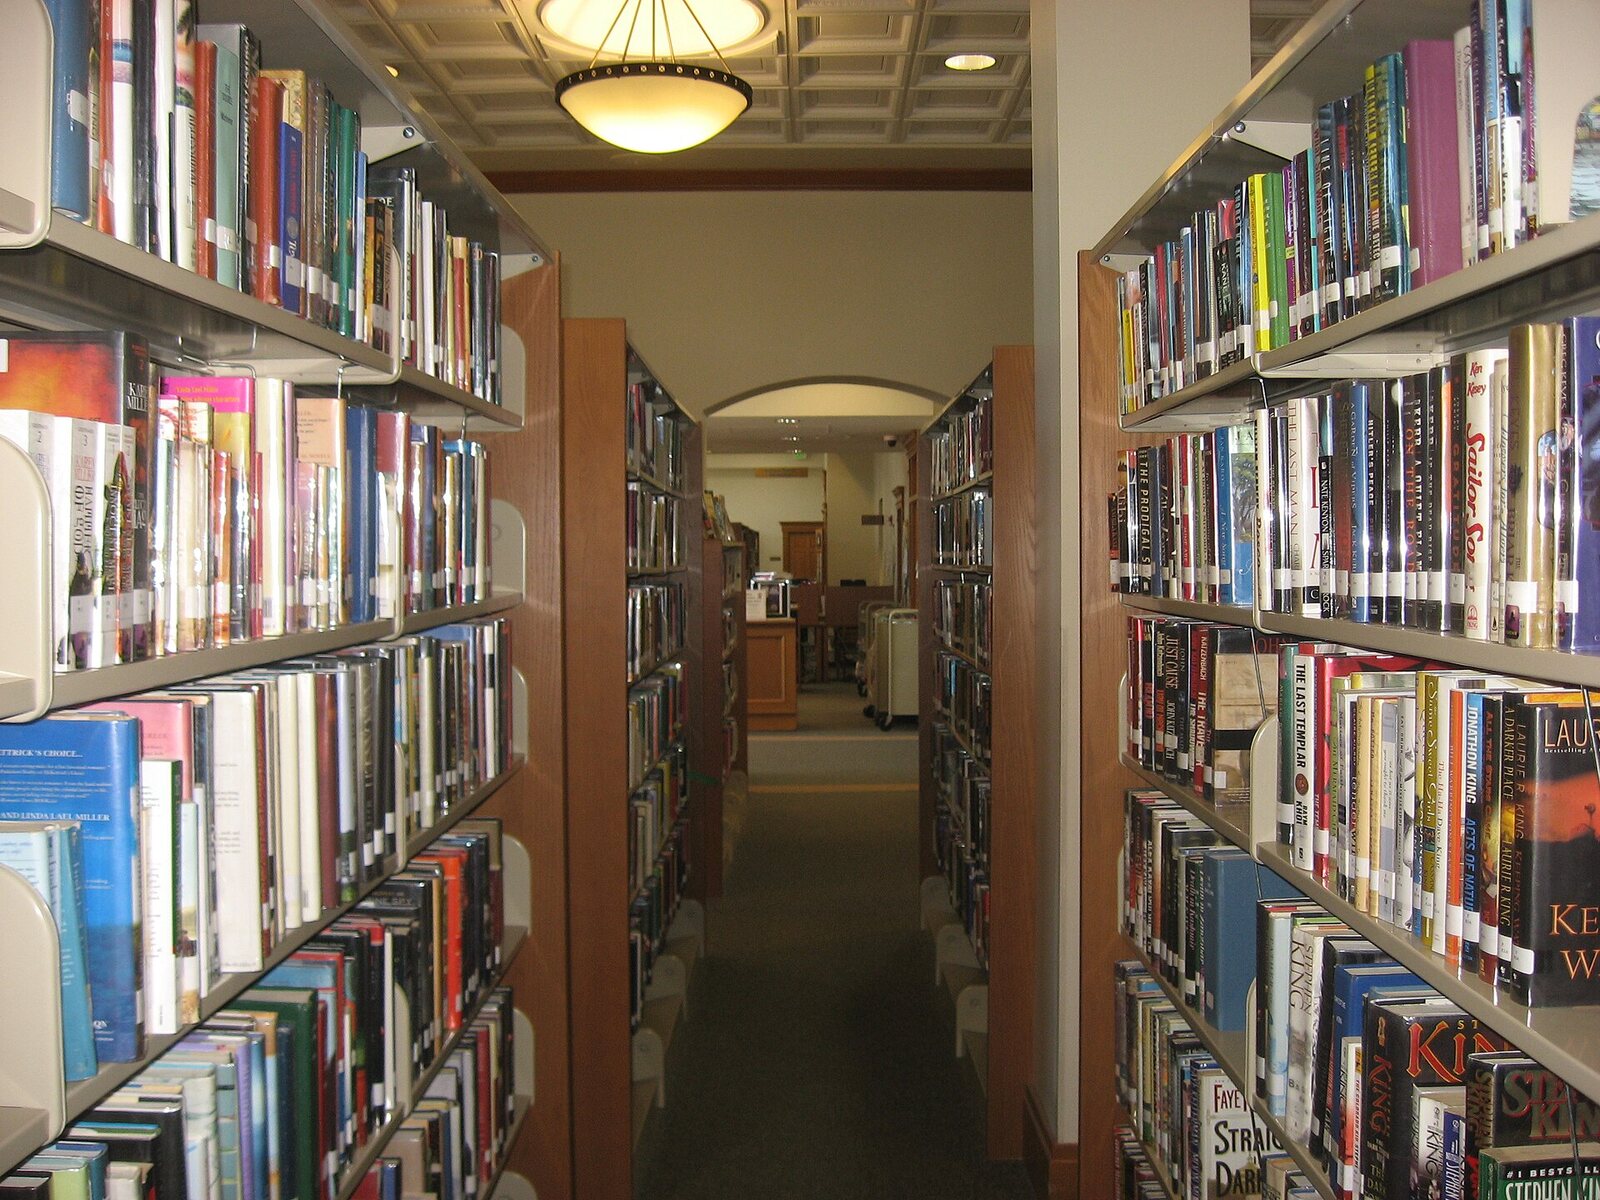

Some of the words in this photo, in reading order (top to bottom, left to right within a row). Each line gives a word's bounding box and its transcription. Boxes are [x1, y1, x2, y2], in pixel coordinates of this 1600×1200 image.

[1321, 138, 1331, 171] LINE
[1371, 208, 1380, 230] TRUE
[1468, 362, 1484, 376] Ken
[1466, 382, 1487, 398] Kesey
[1288, 403, 1297, 433] THE
[1406, 429, 1415, 456] ON
[1140, 462, 1148, 484] THE
[1289, 439, 1298, 483] LAST
[1465, 423, 1486, 517] Sailor
[1320, 479, 1329, 500] NATE
[1406, 467, 1415, 509] THE
[1141, 489, 1151, 550] PRODIGAL
[1289, 490, 1298, 536] MAN
[1320, 501, 1330, 533] KENYON
[1453, 444, 1461, 571] GRATITUDE
[1292, 544, 1300, 569] CHAR
[1321, 551, 1329, 569] SPAR
[1406, 520, 1415, 573] ROAD
[1165, 636, 1179, 661] JUST
[1199, 637, 1208, 681] KATZENBACH
[1165, 662, 1178, 689] CAUSE
[1296, 664, 1306, 683] THE
[1166, 700, 1176, 720] JOHN
[1197, 692, 1207, 711] THE
[1296, 686, 1306, 715] LAST
[1504, 706, 1514, 715] A
[1166, 720, 1176, 760] KATZCH
[1196, 715, 1207, 767] TRAVER
[1296, 722, 1306, 768] TEMPLAR
[1466, 705, 1479, 770] JONATHON
[1503, 718, 1515, 761] DARKER
[1517, 724, 1526, 778] LAURIE
[1466, 773, 1477, 804] KING
[1503, 767, 1514, 801] PLACE
[1, 811, 20, 819] AND
[22, 812, 49, 820] LINDA
[1515, 803, 1525, 840] KING
[1465, 819, 1476, 851] ACTS
[1465, 853, 1475, 869] OF
[1502, 840, 1513, 881] LAURIE
[1501, 896, 1511, 927] KING
[1550, 904, 1600, 935] KE
[1290, 940, 1305, 1010] KING
[1304, 945, 1313, 1015] STEPHEN
[1213, 1084, 1241, 1113] FAYE
[1369, 1053, 1393, 1134] KING
[1425, 1129, 1440, 1175] KING
[1529, 1165, 1600, 1178] BESTSLL
[1505, 1178, 1571, 1200] STEPHEN
